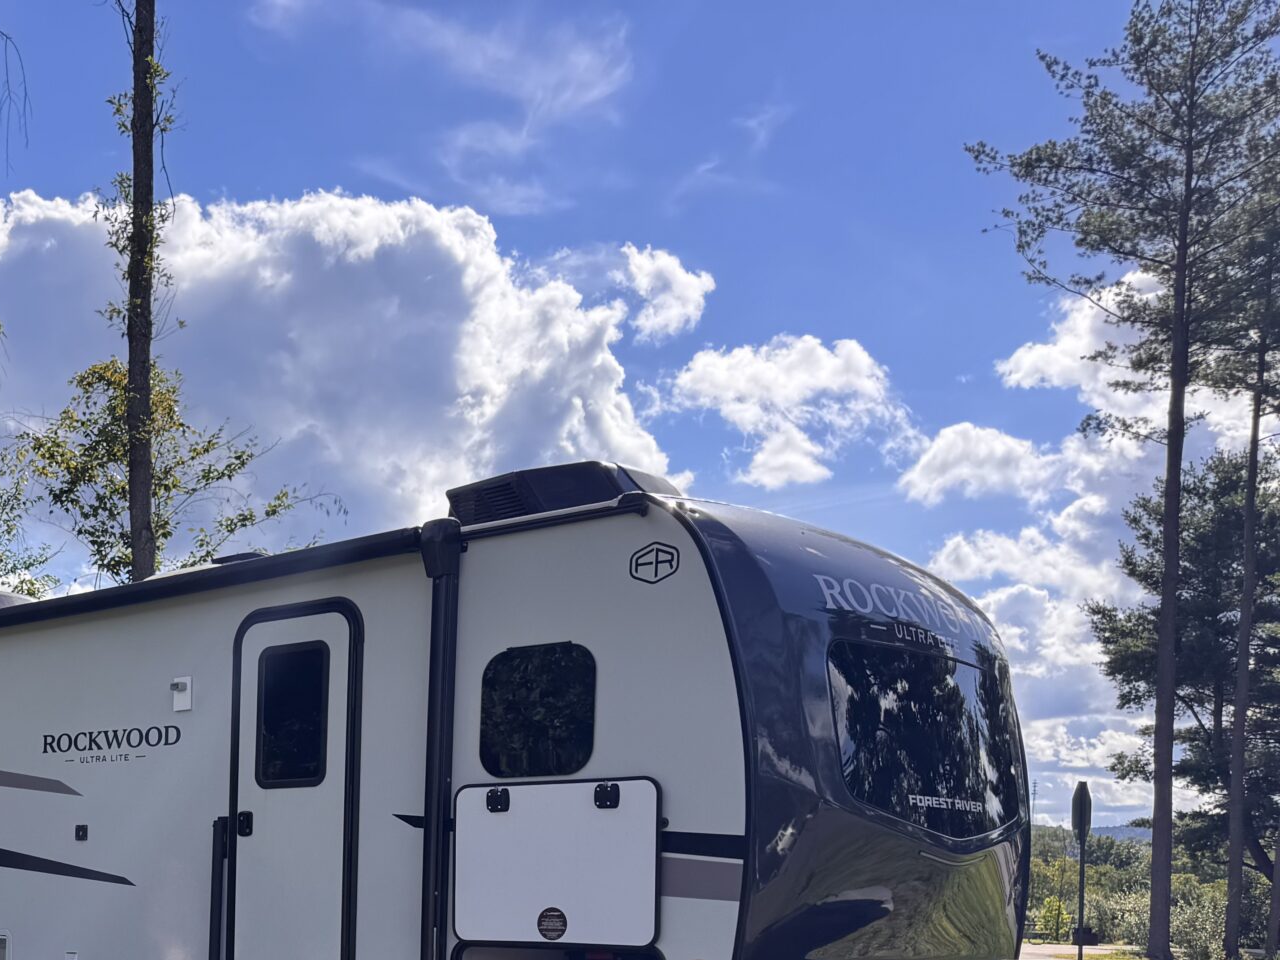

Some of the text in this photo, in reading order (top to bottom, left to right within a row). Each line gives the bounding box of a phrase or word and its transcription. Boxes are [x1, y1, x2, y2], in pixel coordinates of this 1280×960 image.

[894, 623, 934, 646] ULTRA
[42, 725, 182, 754] ROCKWOOD
[79, 753, 130, 764] ULTRA LITE
[908, 794, 983, 813] FOREST RIVER
